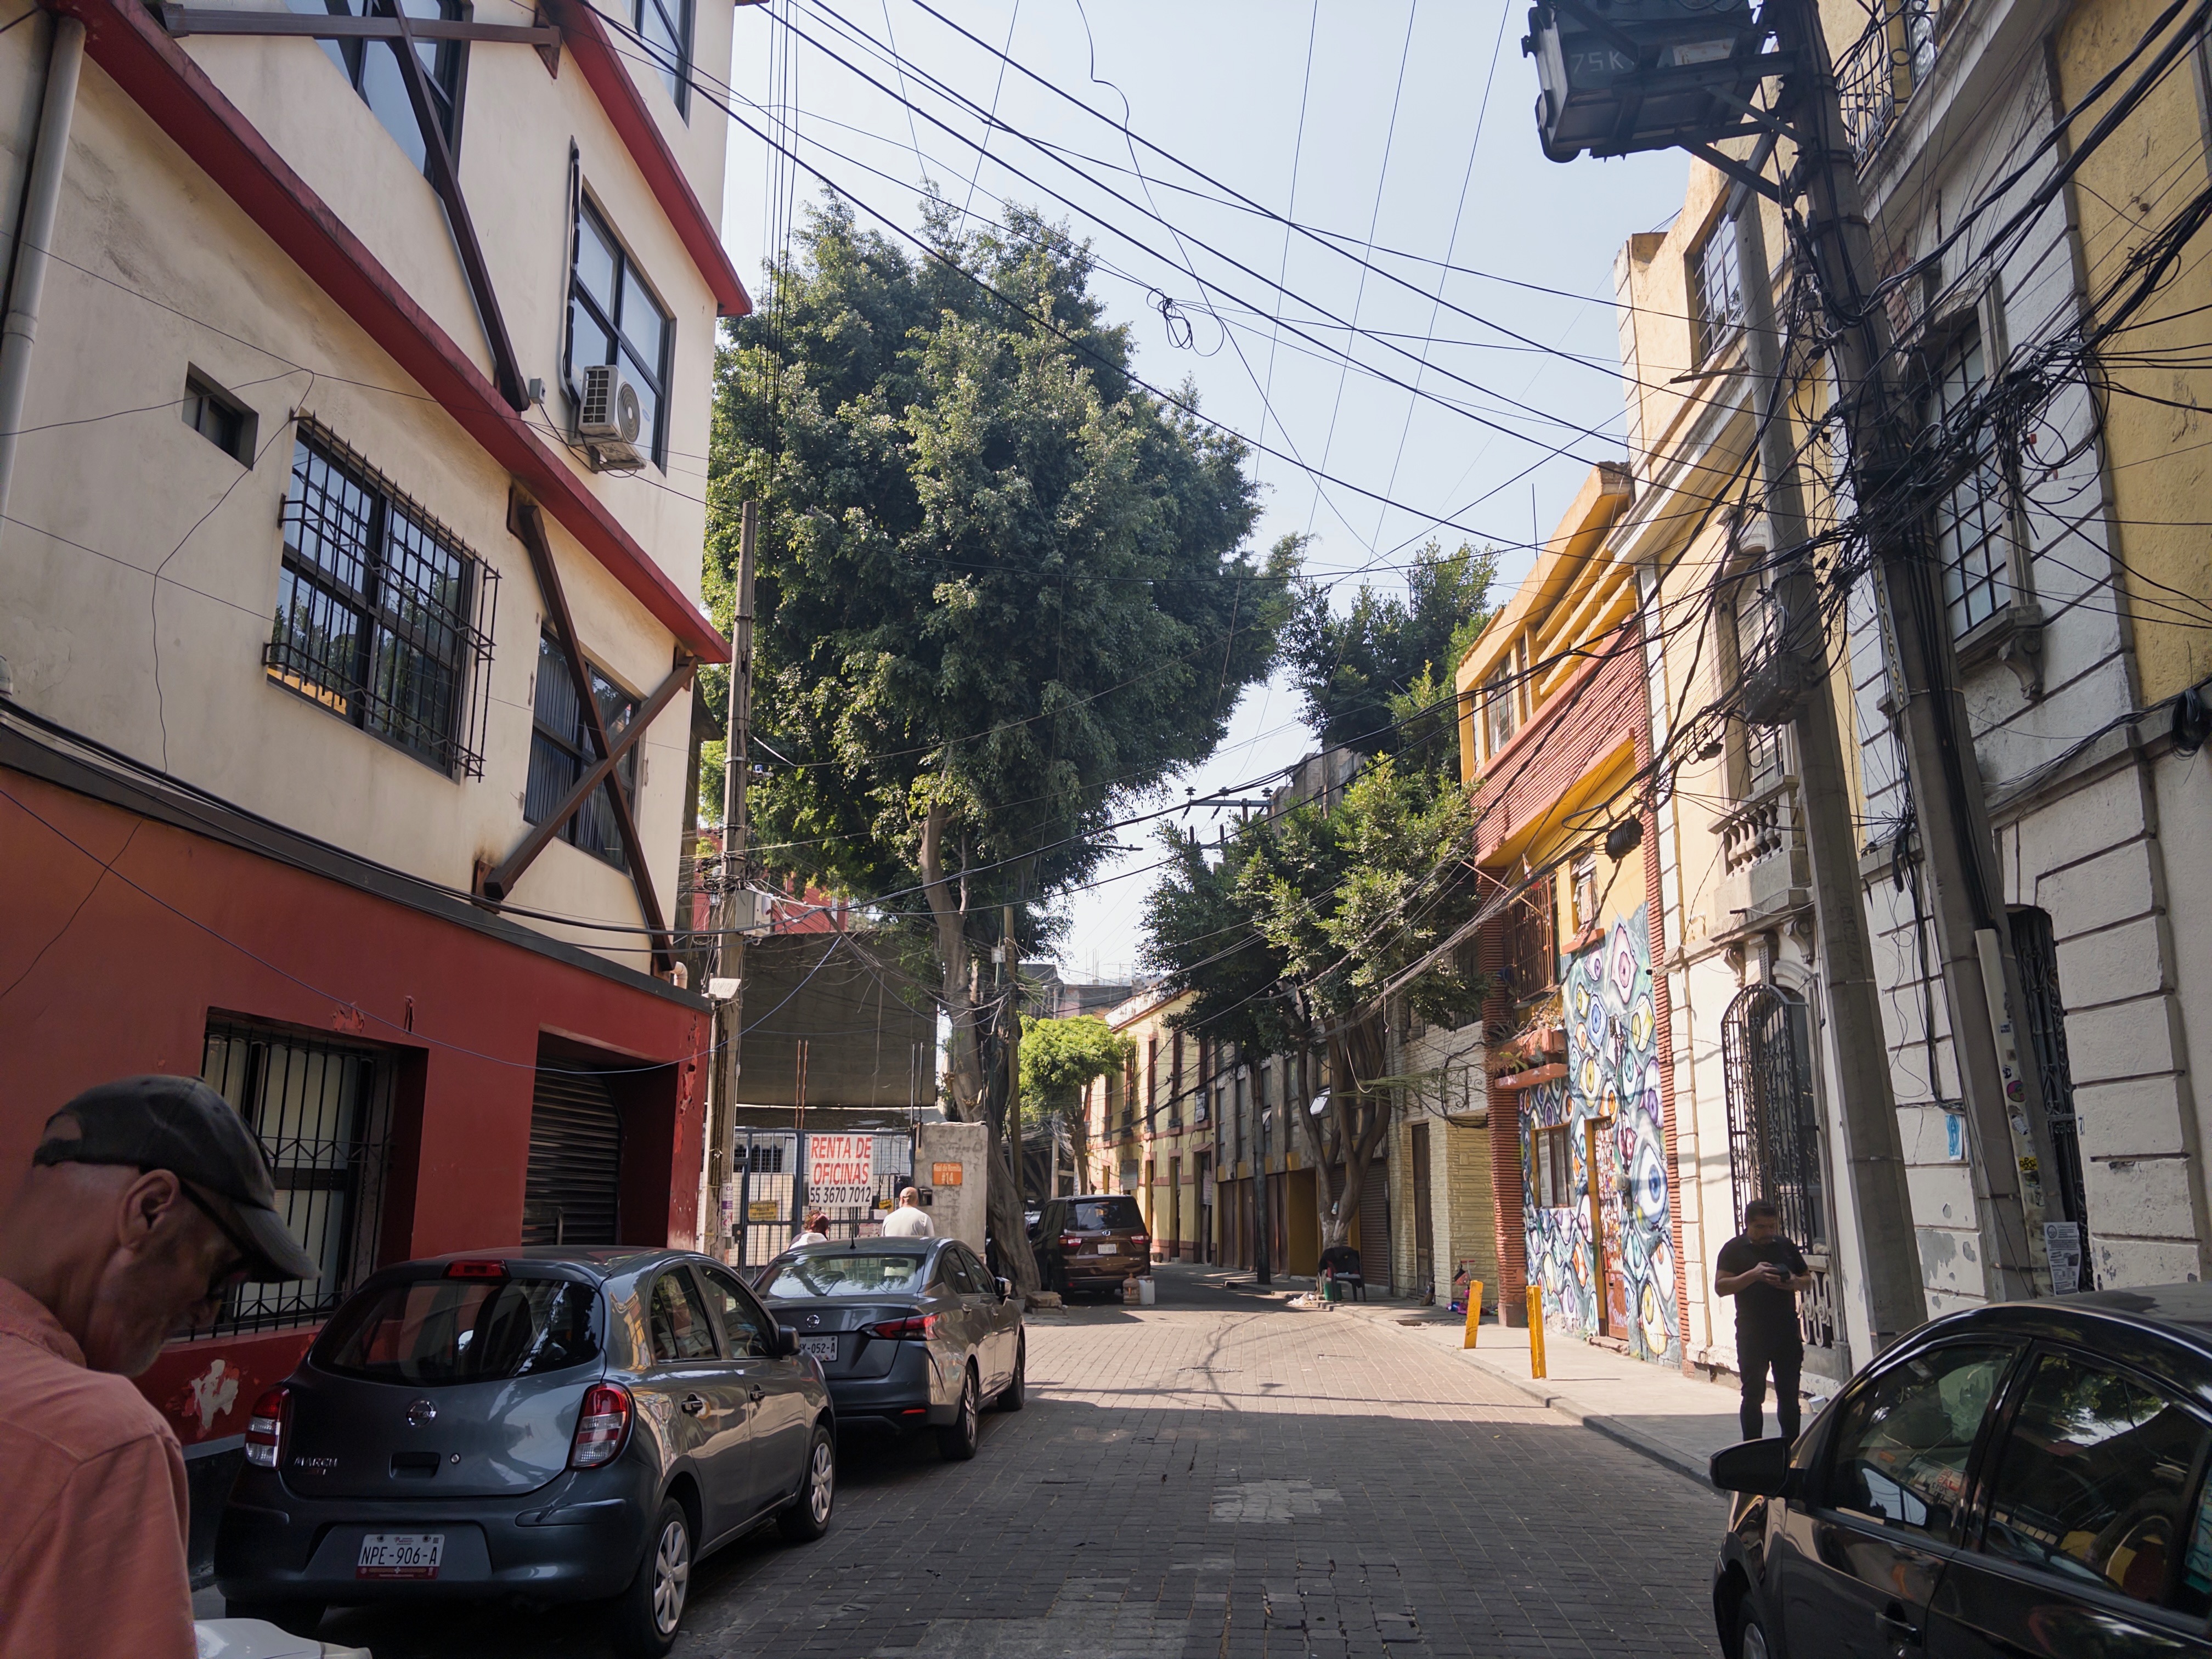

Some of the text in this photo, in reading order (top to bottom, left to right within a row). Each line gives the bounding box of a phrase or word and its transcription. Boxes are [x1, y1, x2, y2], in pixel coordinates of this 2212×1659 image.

[811, 1137, 872, 1159] RENTA DE
[814, 1163, 870, 1185] OFICINAS
[941, 1172, 953, 1184] #14
[810, 1186, 871, 1203] 55 3670 7012
[294, 1456, 338, 1467] MARCH
[361, 1546, 438, 1565] NPE-906-A
